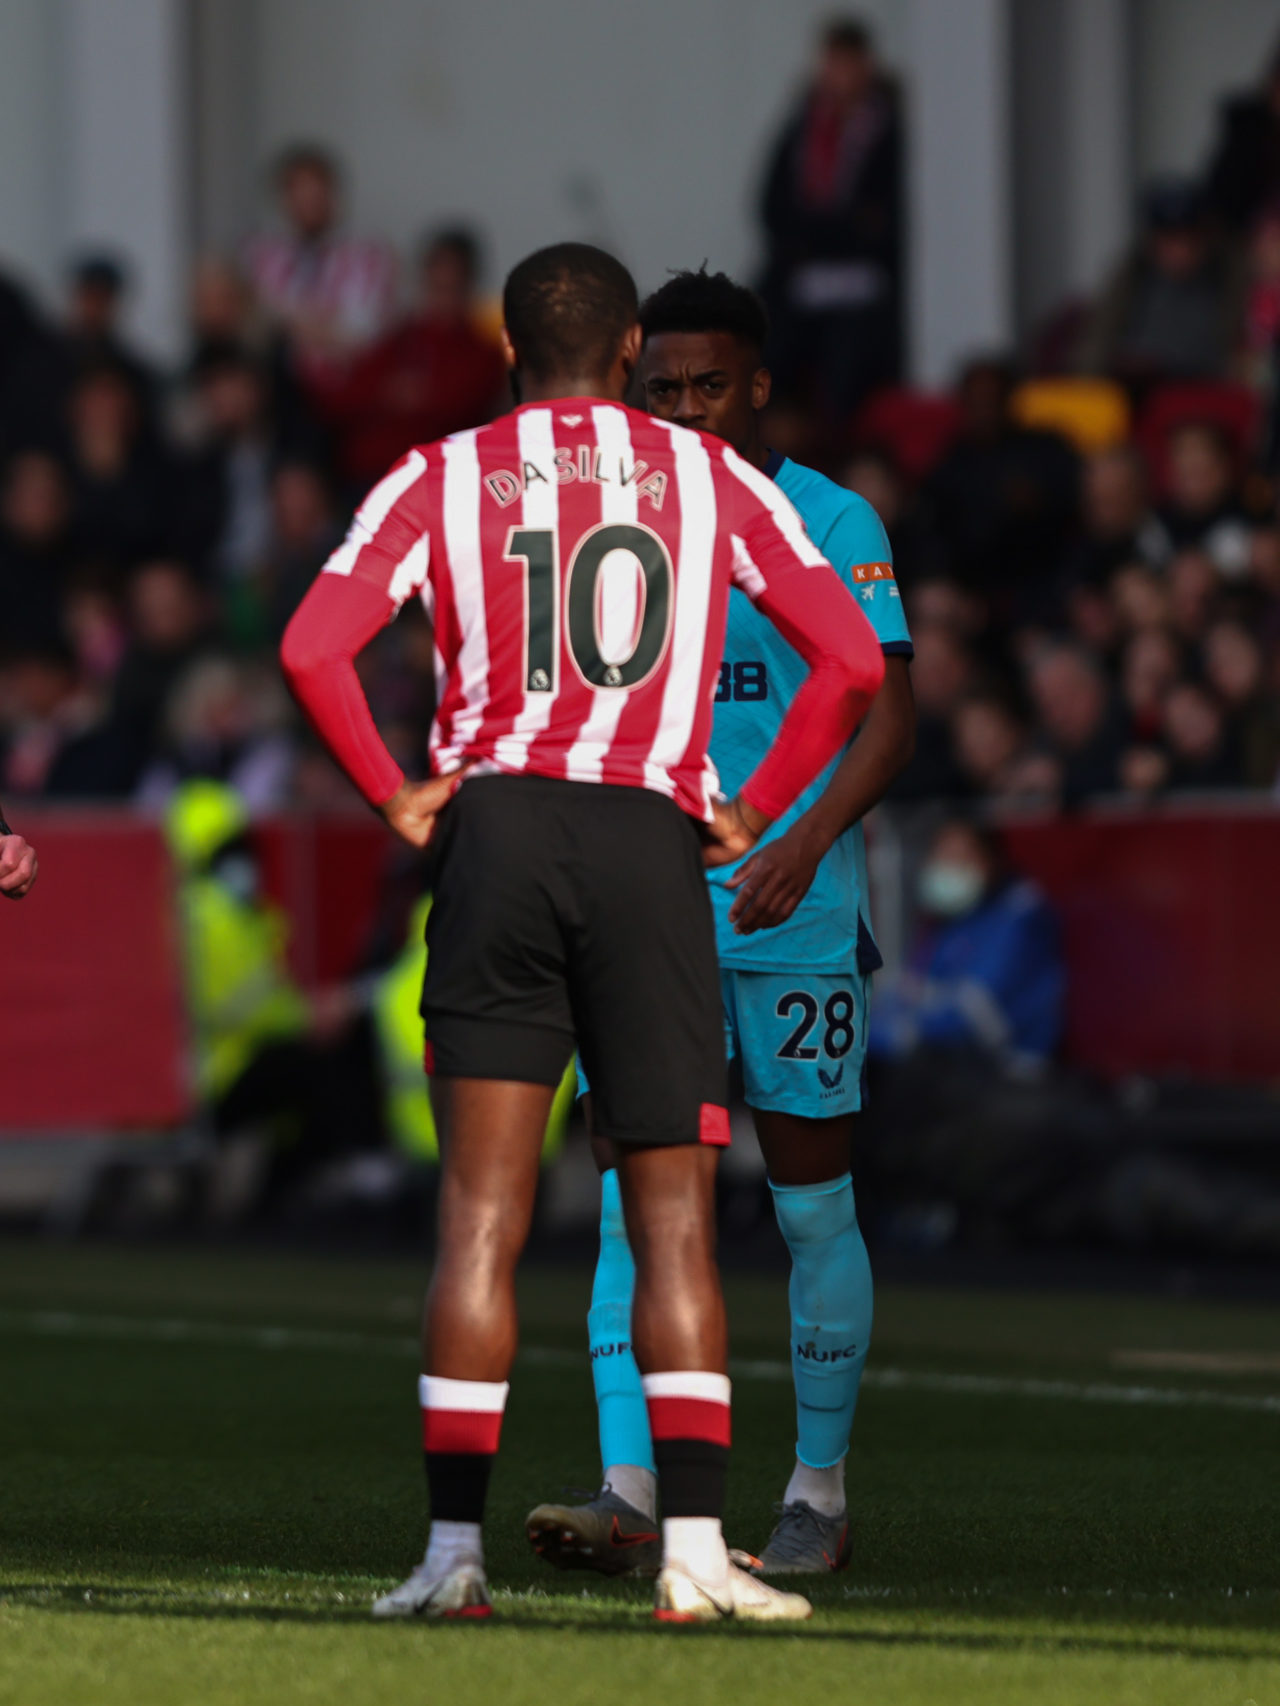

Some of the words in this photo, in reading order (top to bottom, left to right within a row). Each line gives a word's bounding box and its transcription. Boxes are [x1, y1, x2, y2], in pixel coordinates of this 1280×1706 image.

[484, 444, 668, 511] DASILVA
[503, 522, 675, 692] 10
[775, 989, 855, 1061] 28
[797, 1344, 856, 1363] NUFC
